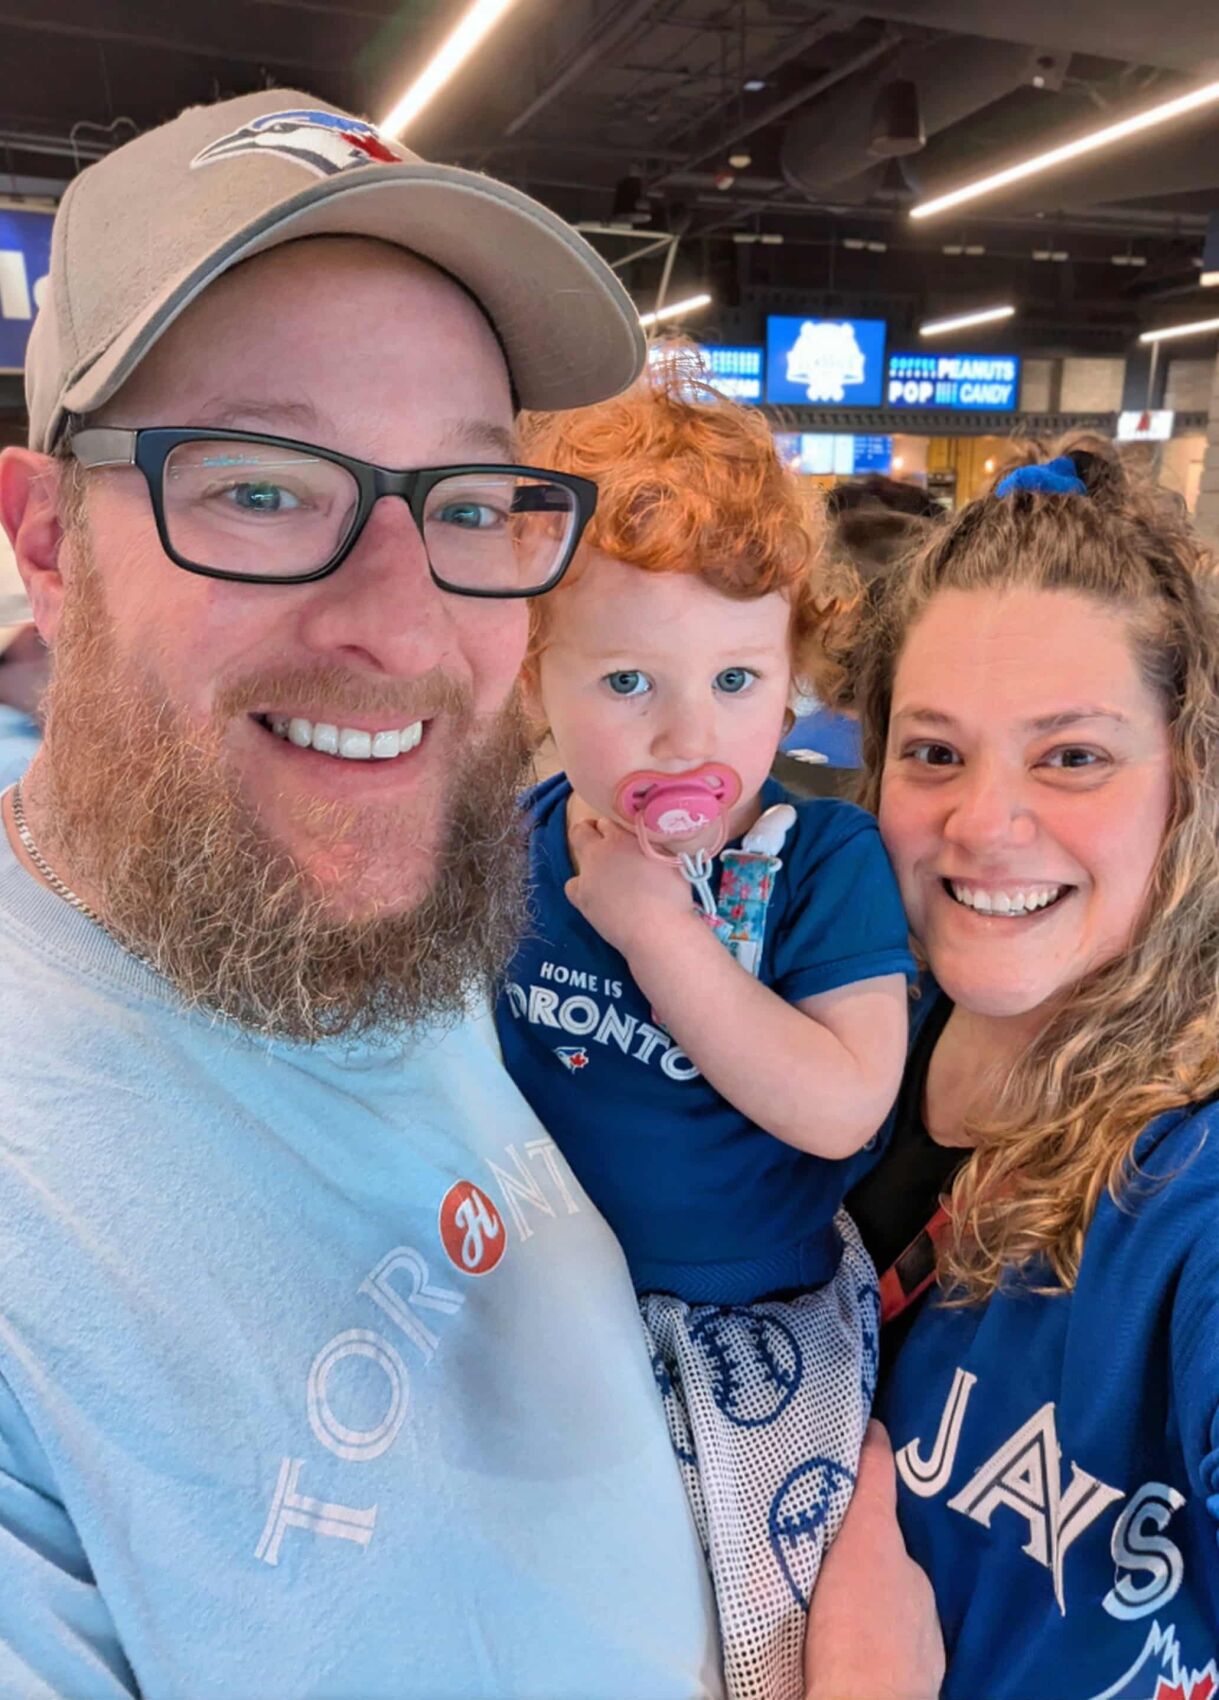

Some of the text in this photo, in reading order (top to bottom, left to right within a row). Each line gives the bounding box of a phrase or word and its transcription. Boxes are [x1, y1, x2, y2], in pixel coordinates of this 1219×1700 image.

[938, 359, 1014, 381] PEANUTS
[888, 381, 1013, 405] POP CANDY
[540, 961, 623, 999] HOME IS
[896, 1367, 1187, 1621] JAYS
